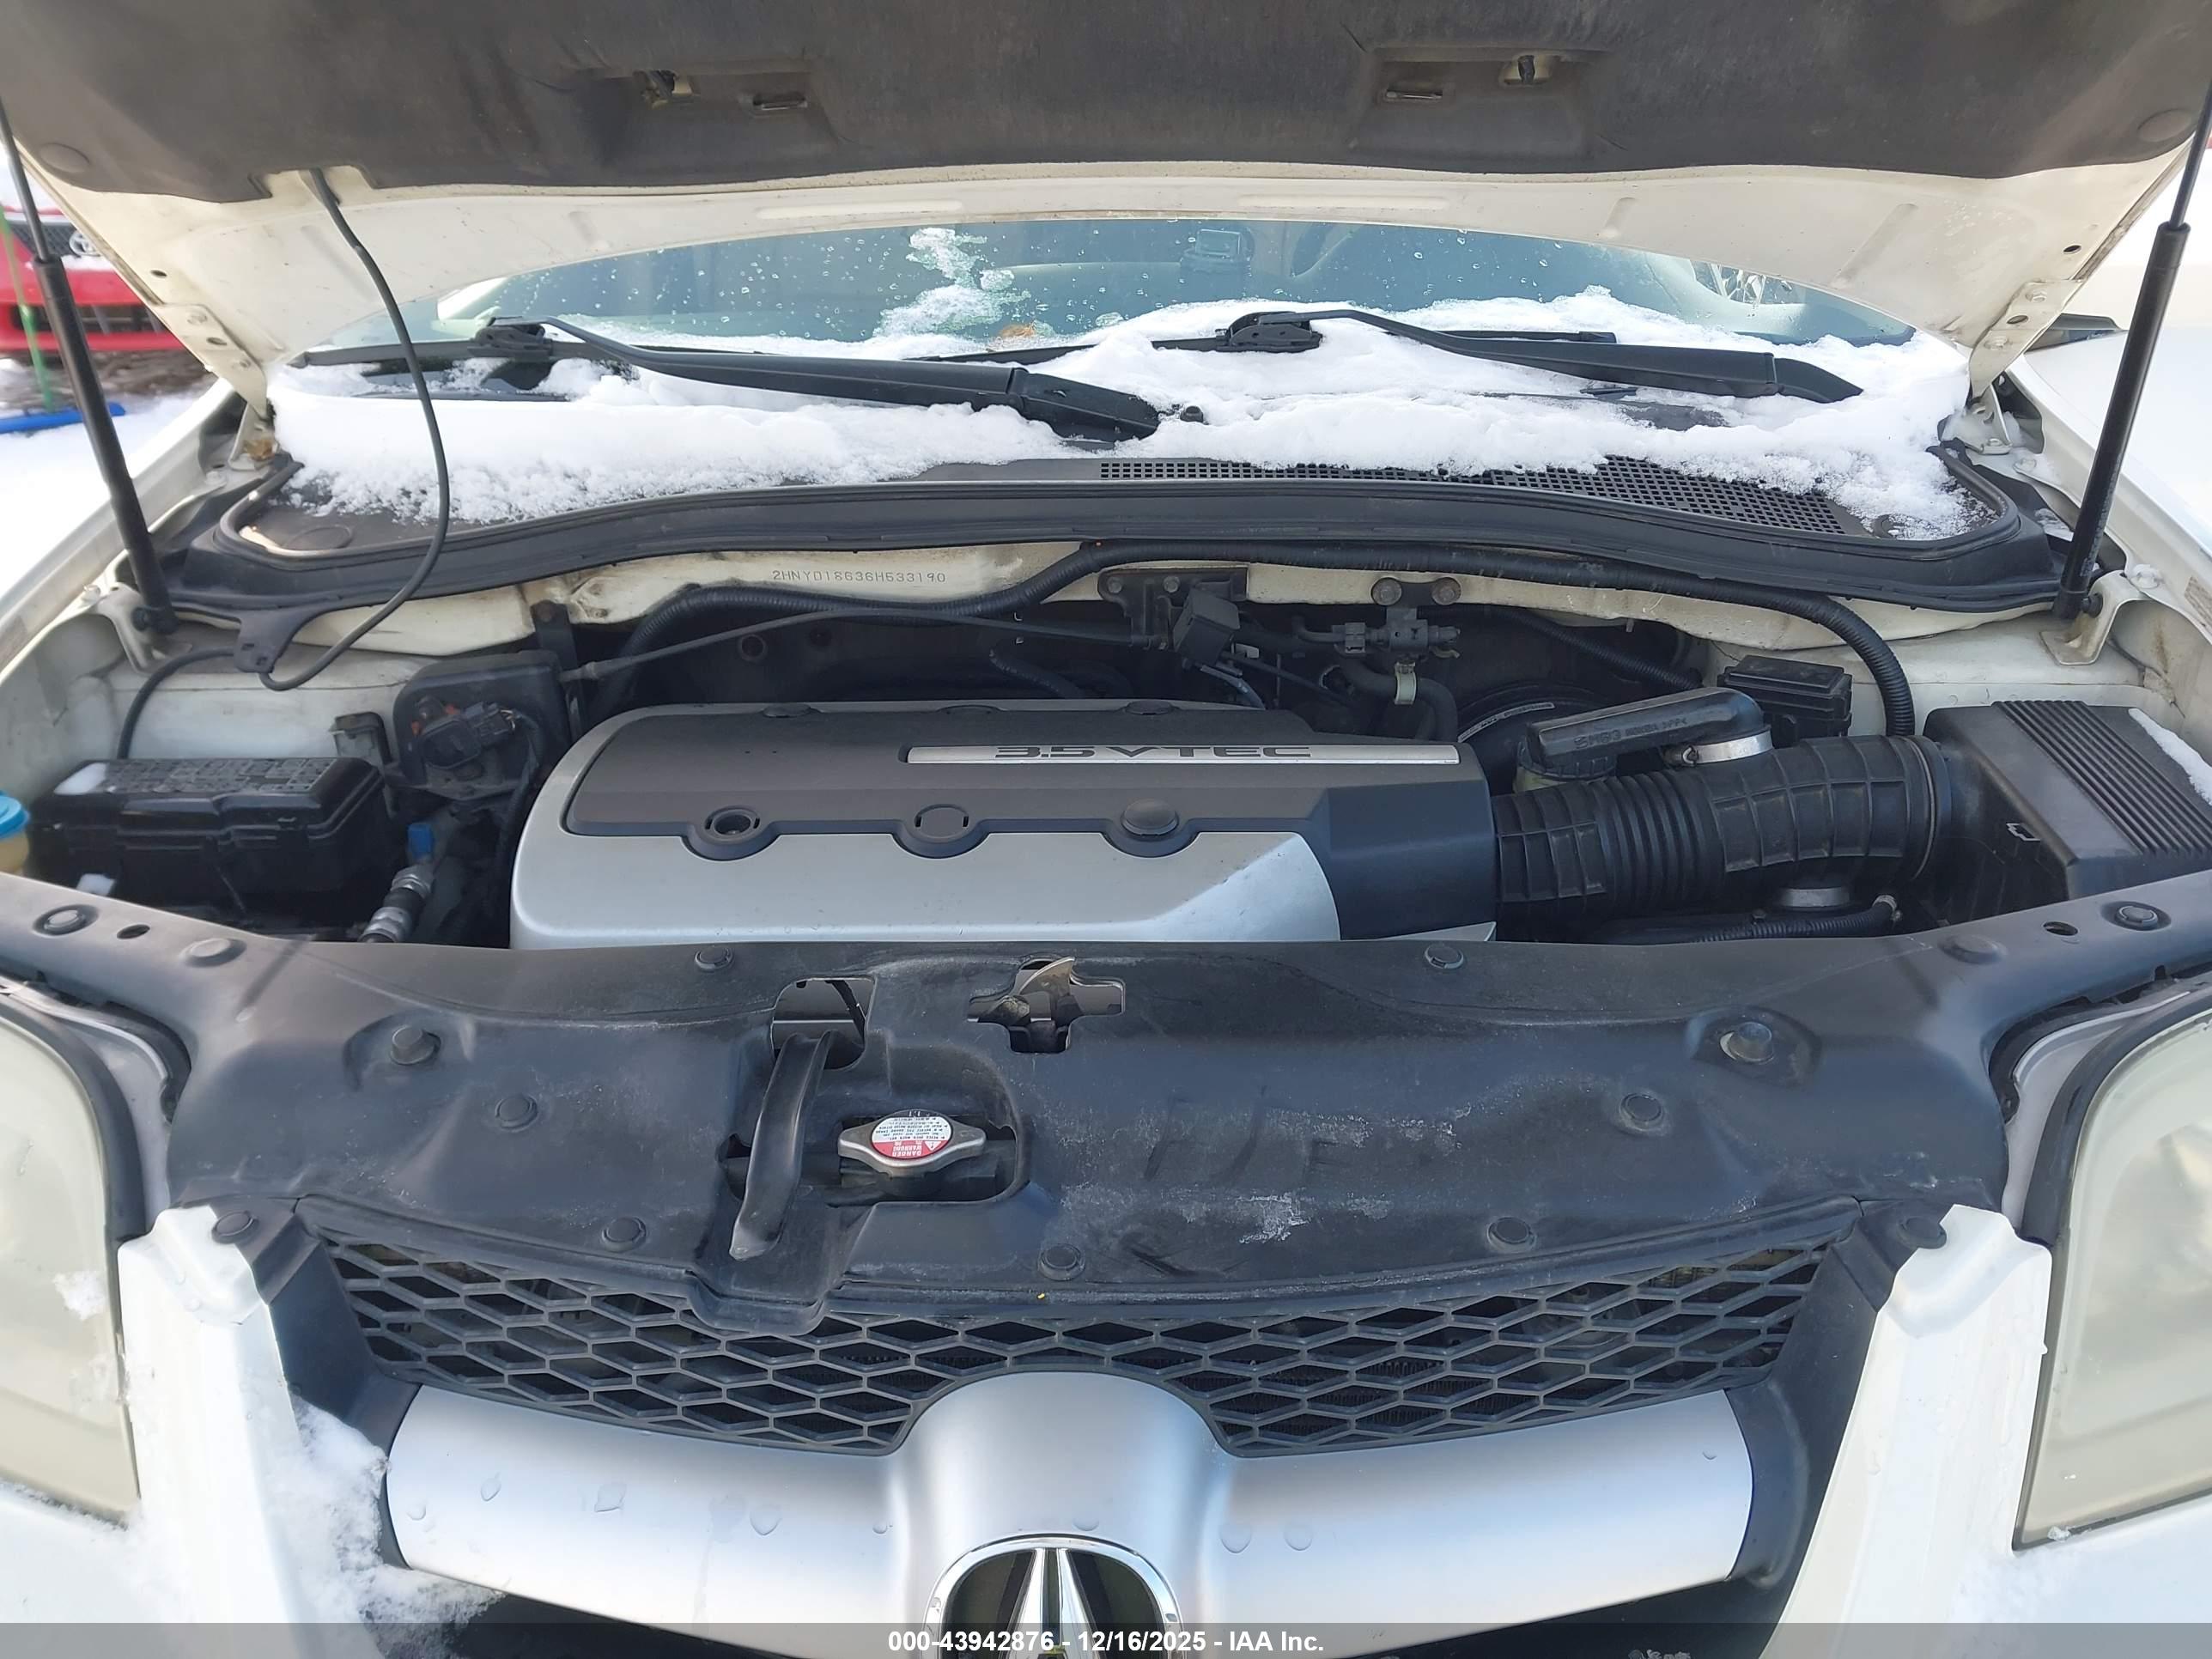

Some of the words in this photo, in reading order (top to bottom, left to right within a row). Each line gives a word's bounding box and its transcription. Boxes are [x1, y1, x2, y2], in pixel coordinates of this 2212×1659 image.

[772, 569, 945, 583] 2HNYD18636H533190
[994, 745, 1095, 758] 3.5
[1104, 745, 1311, 757] VTEC
